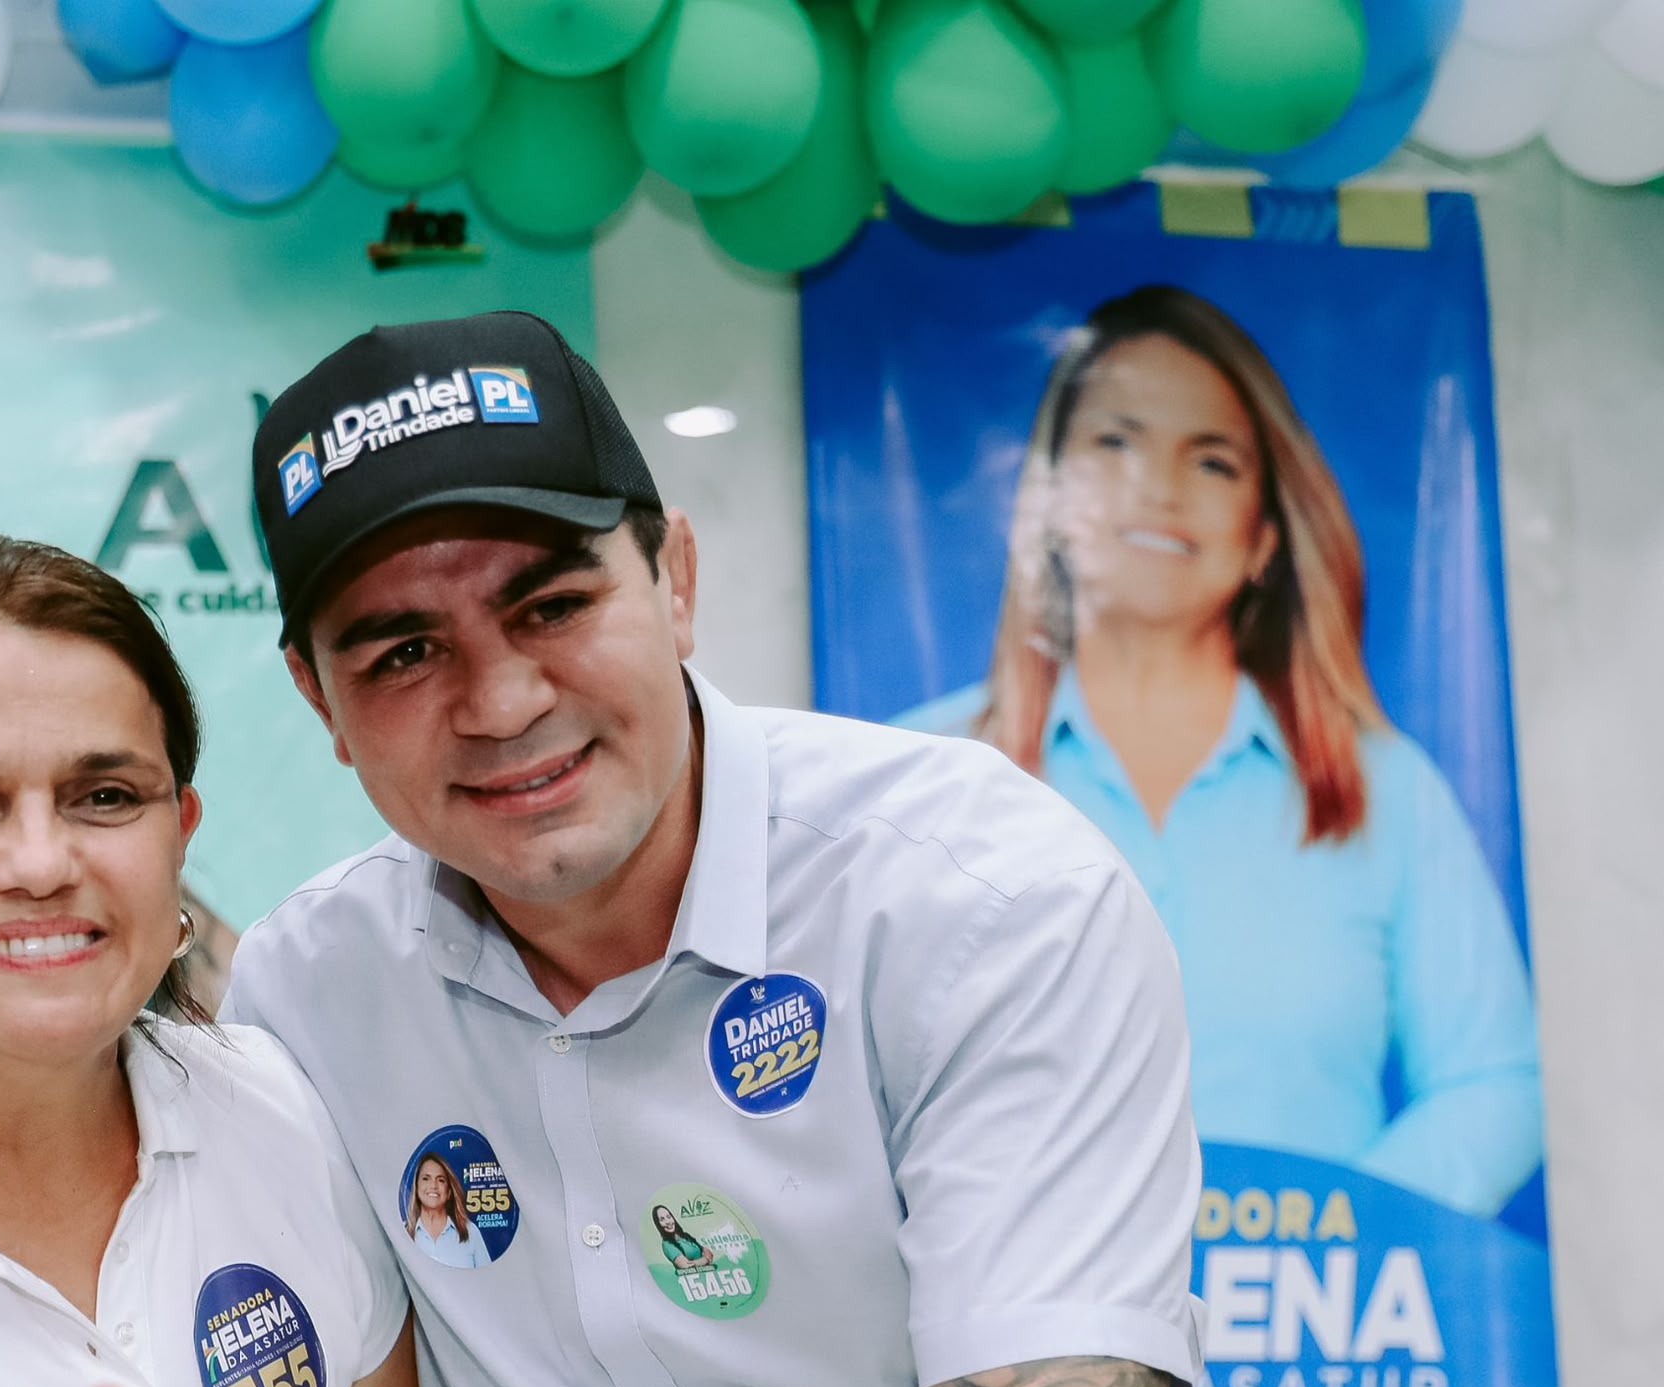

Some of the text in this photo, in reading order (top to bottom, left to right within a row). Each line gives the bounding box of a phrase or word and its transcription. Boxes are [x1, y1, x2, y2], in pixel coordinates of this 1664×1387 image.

[333, 371, 471, 447] Daniel
[481, 380, 529, 407] PL
[363, 406, 475, 452] Trindade
[285, 453, 314, 499] PL
[724, 995, 811, 1049] DANIEL
[730, 1013, 813, 1063] TRINDADE
[731, 1029, 819, 1098] 2222
[463, 1168, 505, 1184] HELENA
[466, 1188, 511, 1214] 555
[1196, 1188, 1358, 1242] DORA
[207, 1288, 274, 1332] SENADORA
[678, 1269, 752, 1303] 15456
[1203, 1246, 1446, 1363] ENA
[200, 1295, 295, 1383] HELENA
[228, 1319, 301, 1369] DA ASATUR
